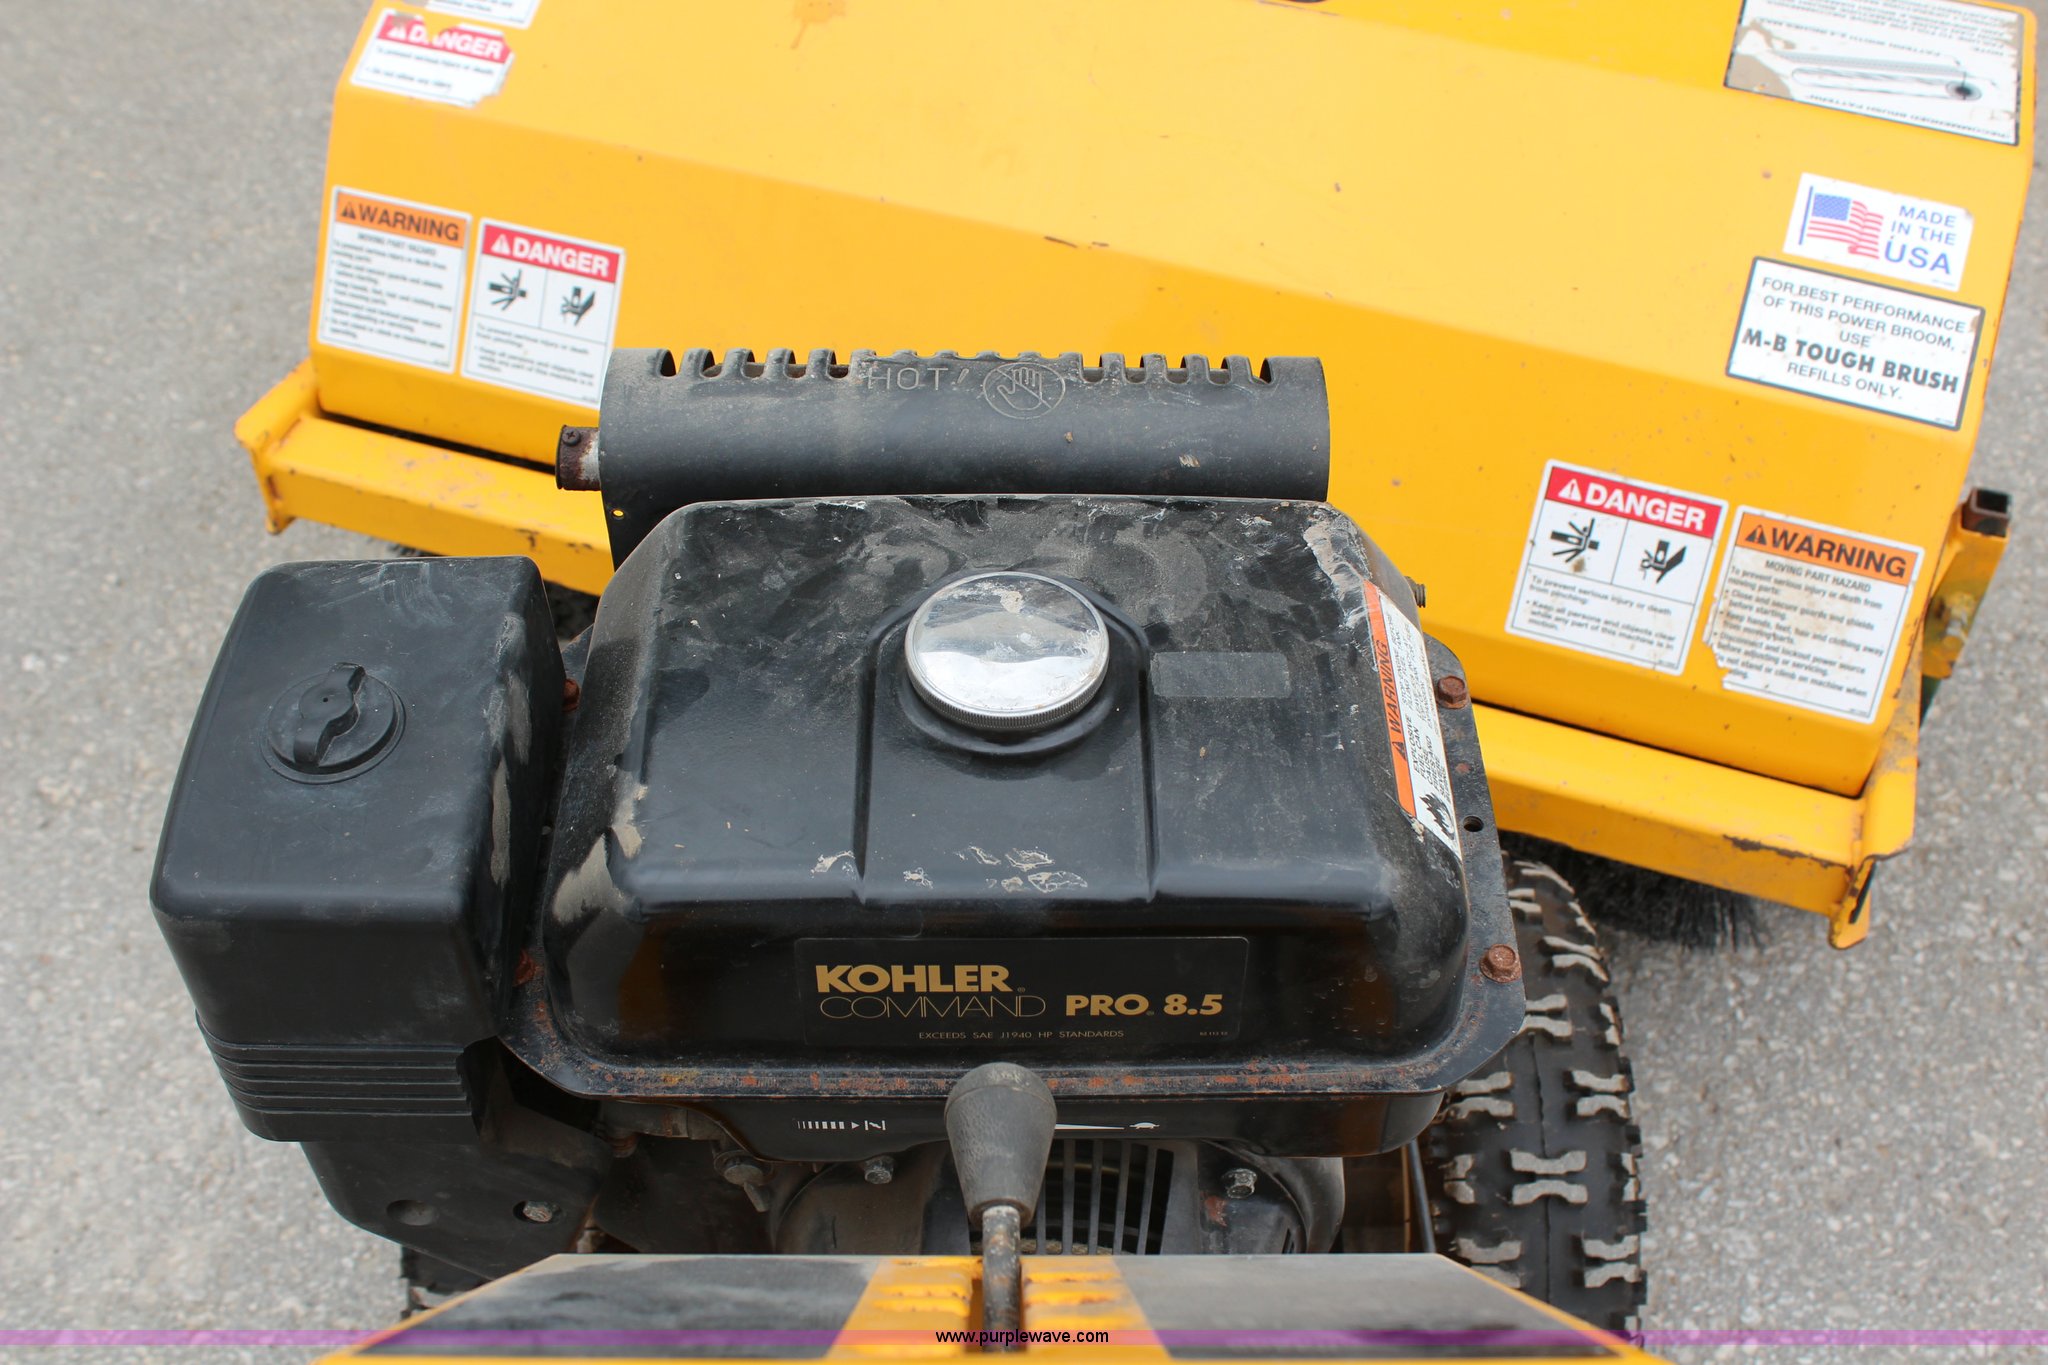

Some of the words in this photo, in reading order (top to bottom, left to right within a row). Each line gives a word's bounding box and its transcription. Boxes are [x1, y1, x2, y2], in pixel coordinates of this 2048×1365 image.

[357, 203, 460, 242] WARNING
[1890, 219, 1911, 235] IN
[1918, 226, 1956, 246] THE
[1898, 203, 1956, 228] MADE
[511, 236, 610, 277] DANGER
[1883, 239, 1953, 275] USA
[1761, 276, 1794, 294] FOR
[1797, 284, 1839, 304] BEST
[1842, 294, 1965, 333] PERFORMANCE
[1762, 294, 1784, 309] OF
[1788, 300, 1824, 318] THIS
[1827, 309, 1886, 333] POWER
[1890, 323, 1956, 350] BROOM,
[1838, 329, 1871, 348] USE
[1741, 327, 1788, 353] M-B
[1793, 339, 1875, 373] TOUGH
[1881, 360, 1958, 393] BRUSH
[1787, 361, 1851, 387] REFILLS
[1854, 377, 1903, 400] ONLY.
[1584, 482, 1707, 531] DANGER
[1767, 527, 1908, 578] WARNING
[1764, 559, 1803, 576] MOVING
[1804, 569, 1830, 582] PART
[1831, 576, 1871, 592] HAZARD
[1376, 639, 1401, 733] WARNING
[1405, 713, 1419, 773] EXPLOSIVE
[1413, 727, 1422, 750] CAN
[1417, 753, 1426, 778] FUEL
[1423, 749, 1432, 785] CAUSE
[815, 964, 1013, 993] KOHLER
[819, 995, 1046, 1019] COMMAND
[1065, 993, 1150, 1017] PRO
[1163, 993, 1223, 1016] 8.5
[918, 1031, 967, 1040] EXCEEDS
[972, 1031, 994, 1040] SAE
[1038, 1031, 1053, 1040] HP
[1058, 1030, 1125, 1039] STANDARDS
